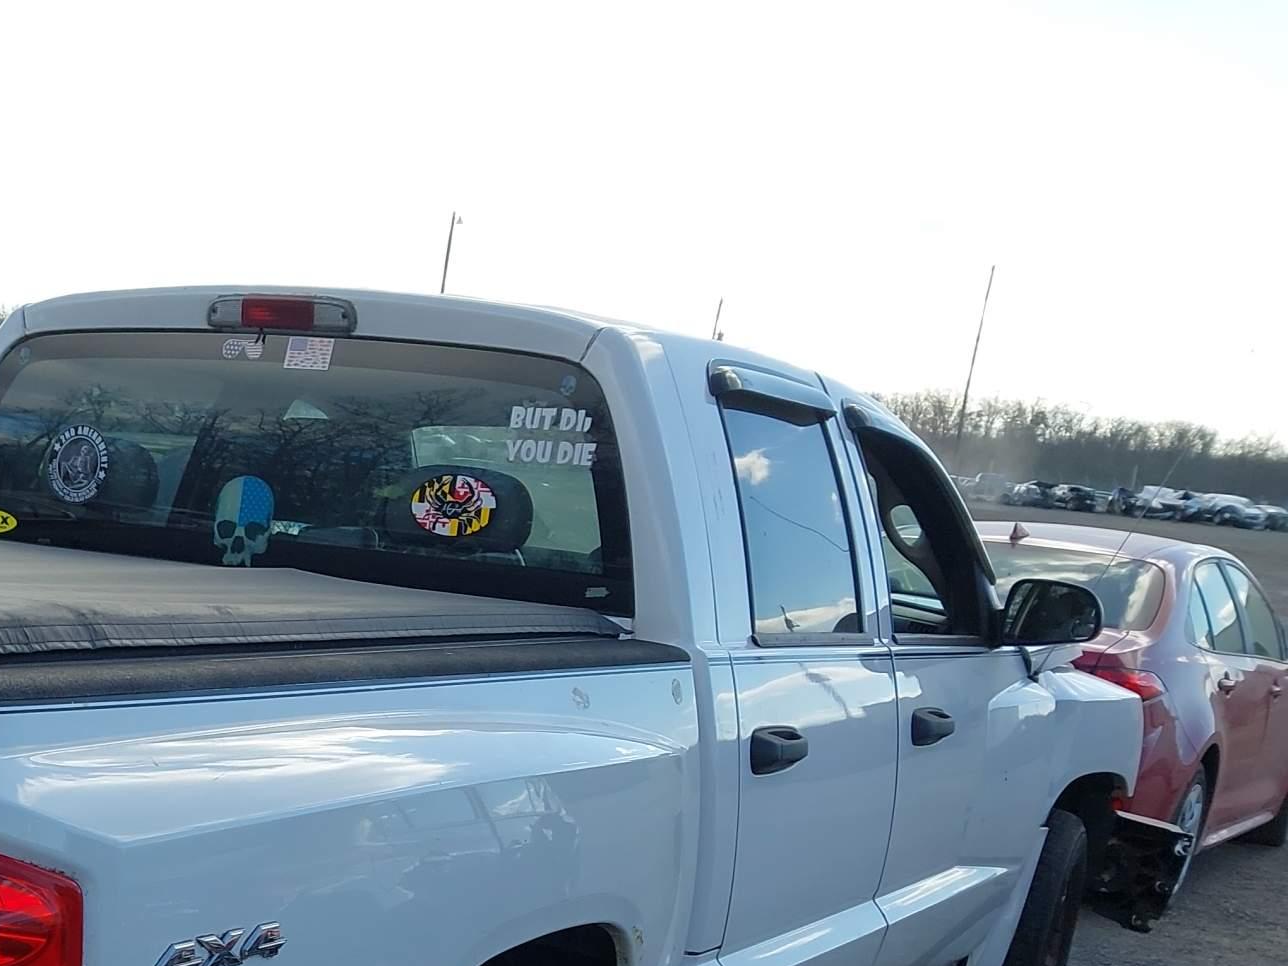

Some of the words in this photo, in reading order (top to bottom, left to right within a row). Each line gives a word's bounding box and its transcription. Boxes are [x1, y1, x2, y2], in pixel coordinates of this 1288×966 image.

[510, 406, 557, 430] BUT
[60, 427, 76, 443] 2ND
[77, 425, 109, 469] AMENDMENT
[506, 439, 553, 463] YOU
[556, 441, 598, 466] DIE
